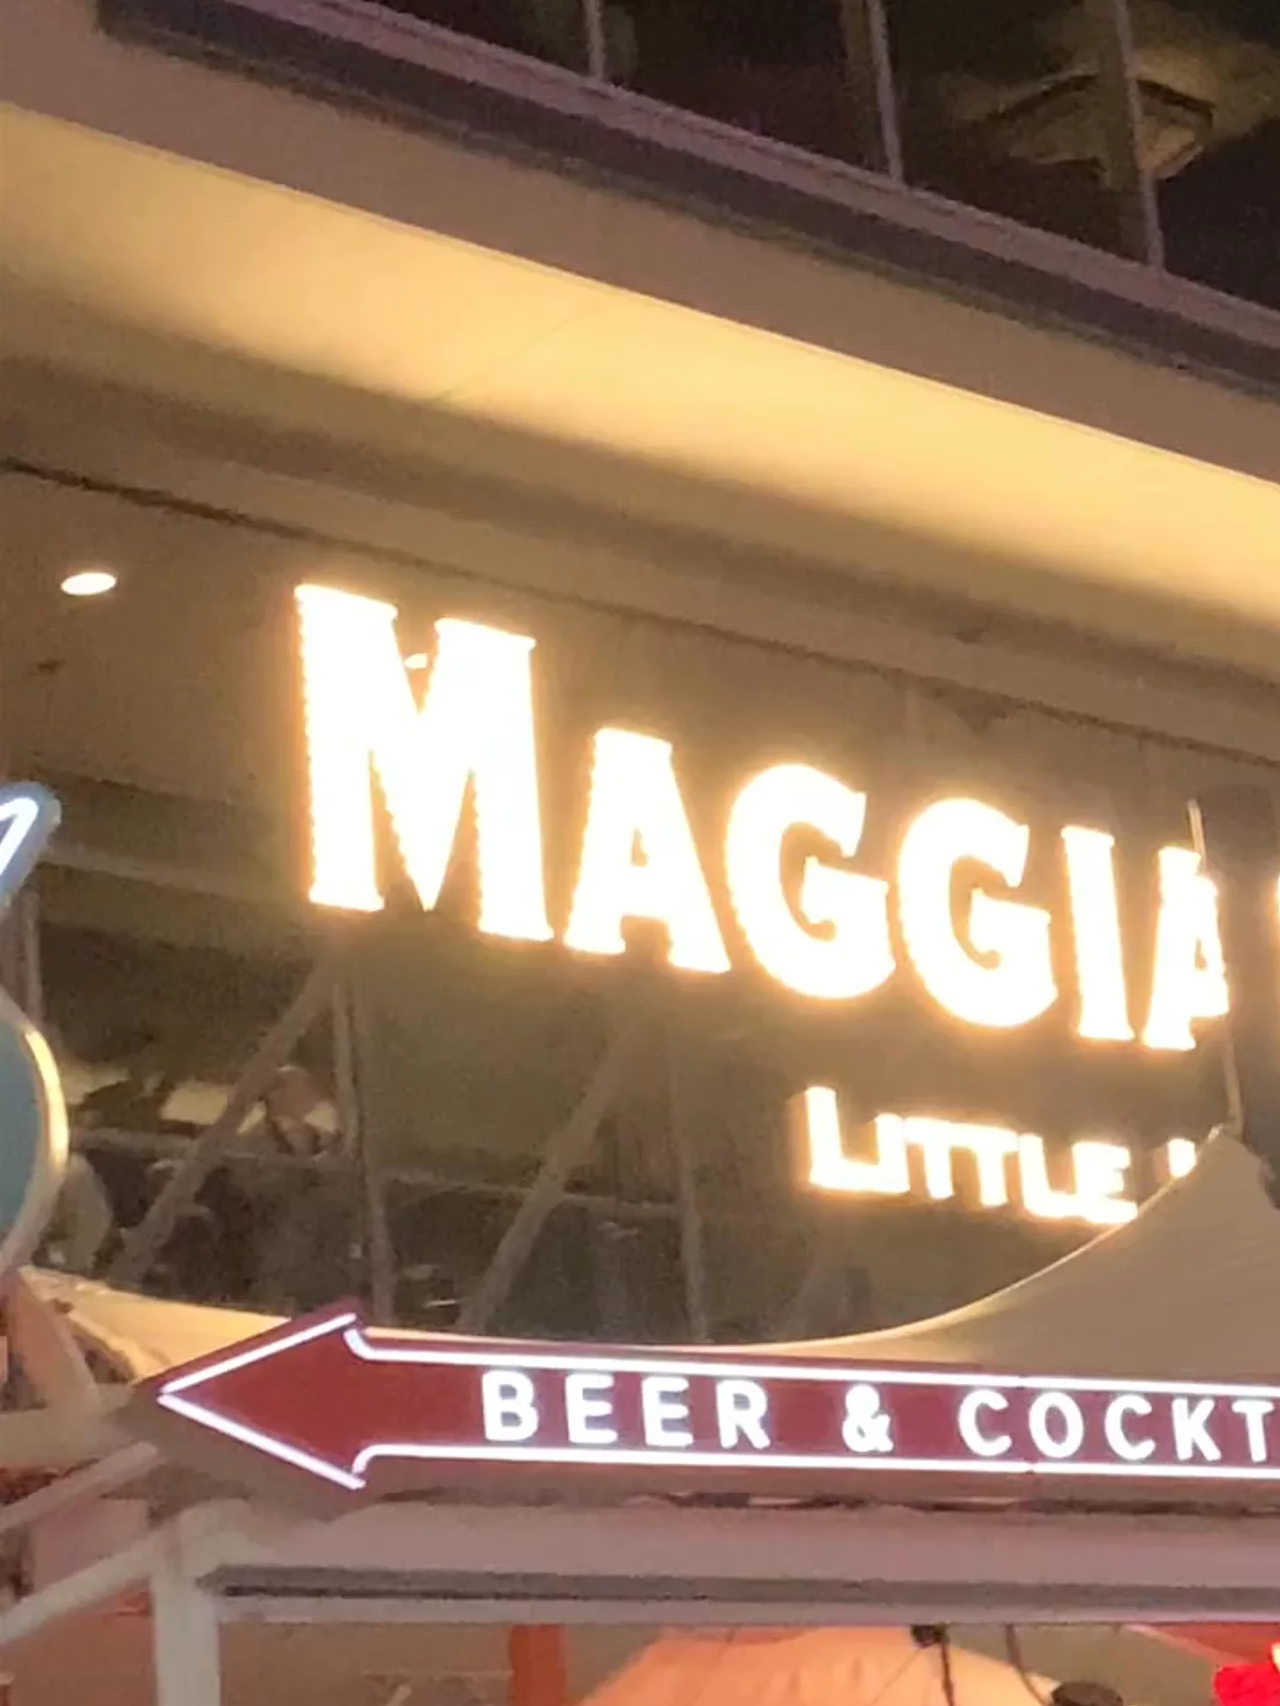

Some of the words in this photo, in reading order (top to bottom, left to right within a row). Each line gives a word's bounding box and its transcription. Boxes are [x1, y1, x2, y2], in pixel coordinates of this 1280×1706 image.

[804, 1084, 1140, 1226] LITTLE
[482, 1366, 772, 1452] BEER
[842, 1386, 896, 1454] &
